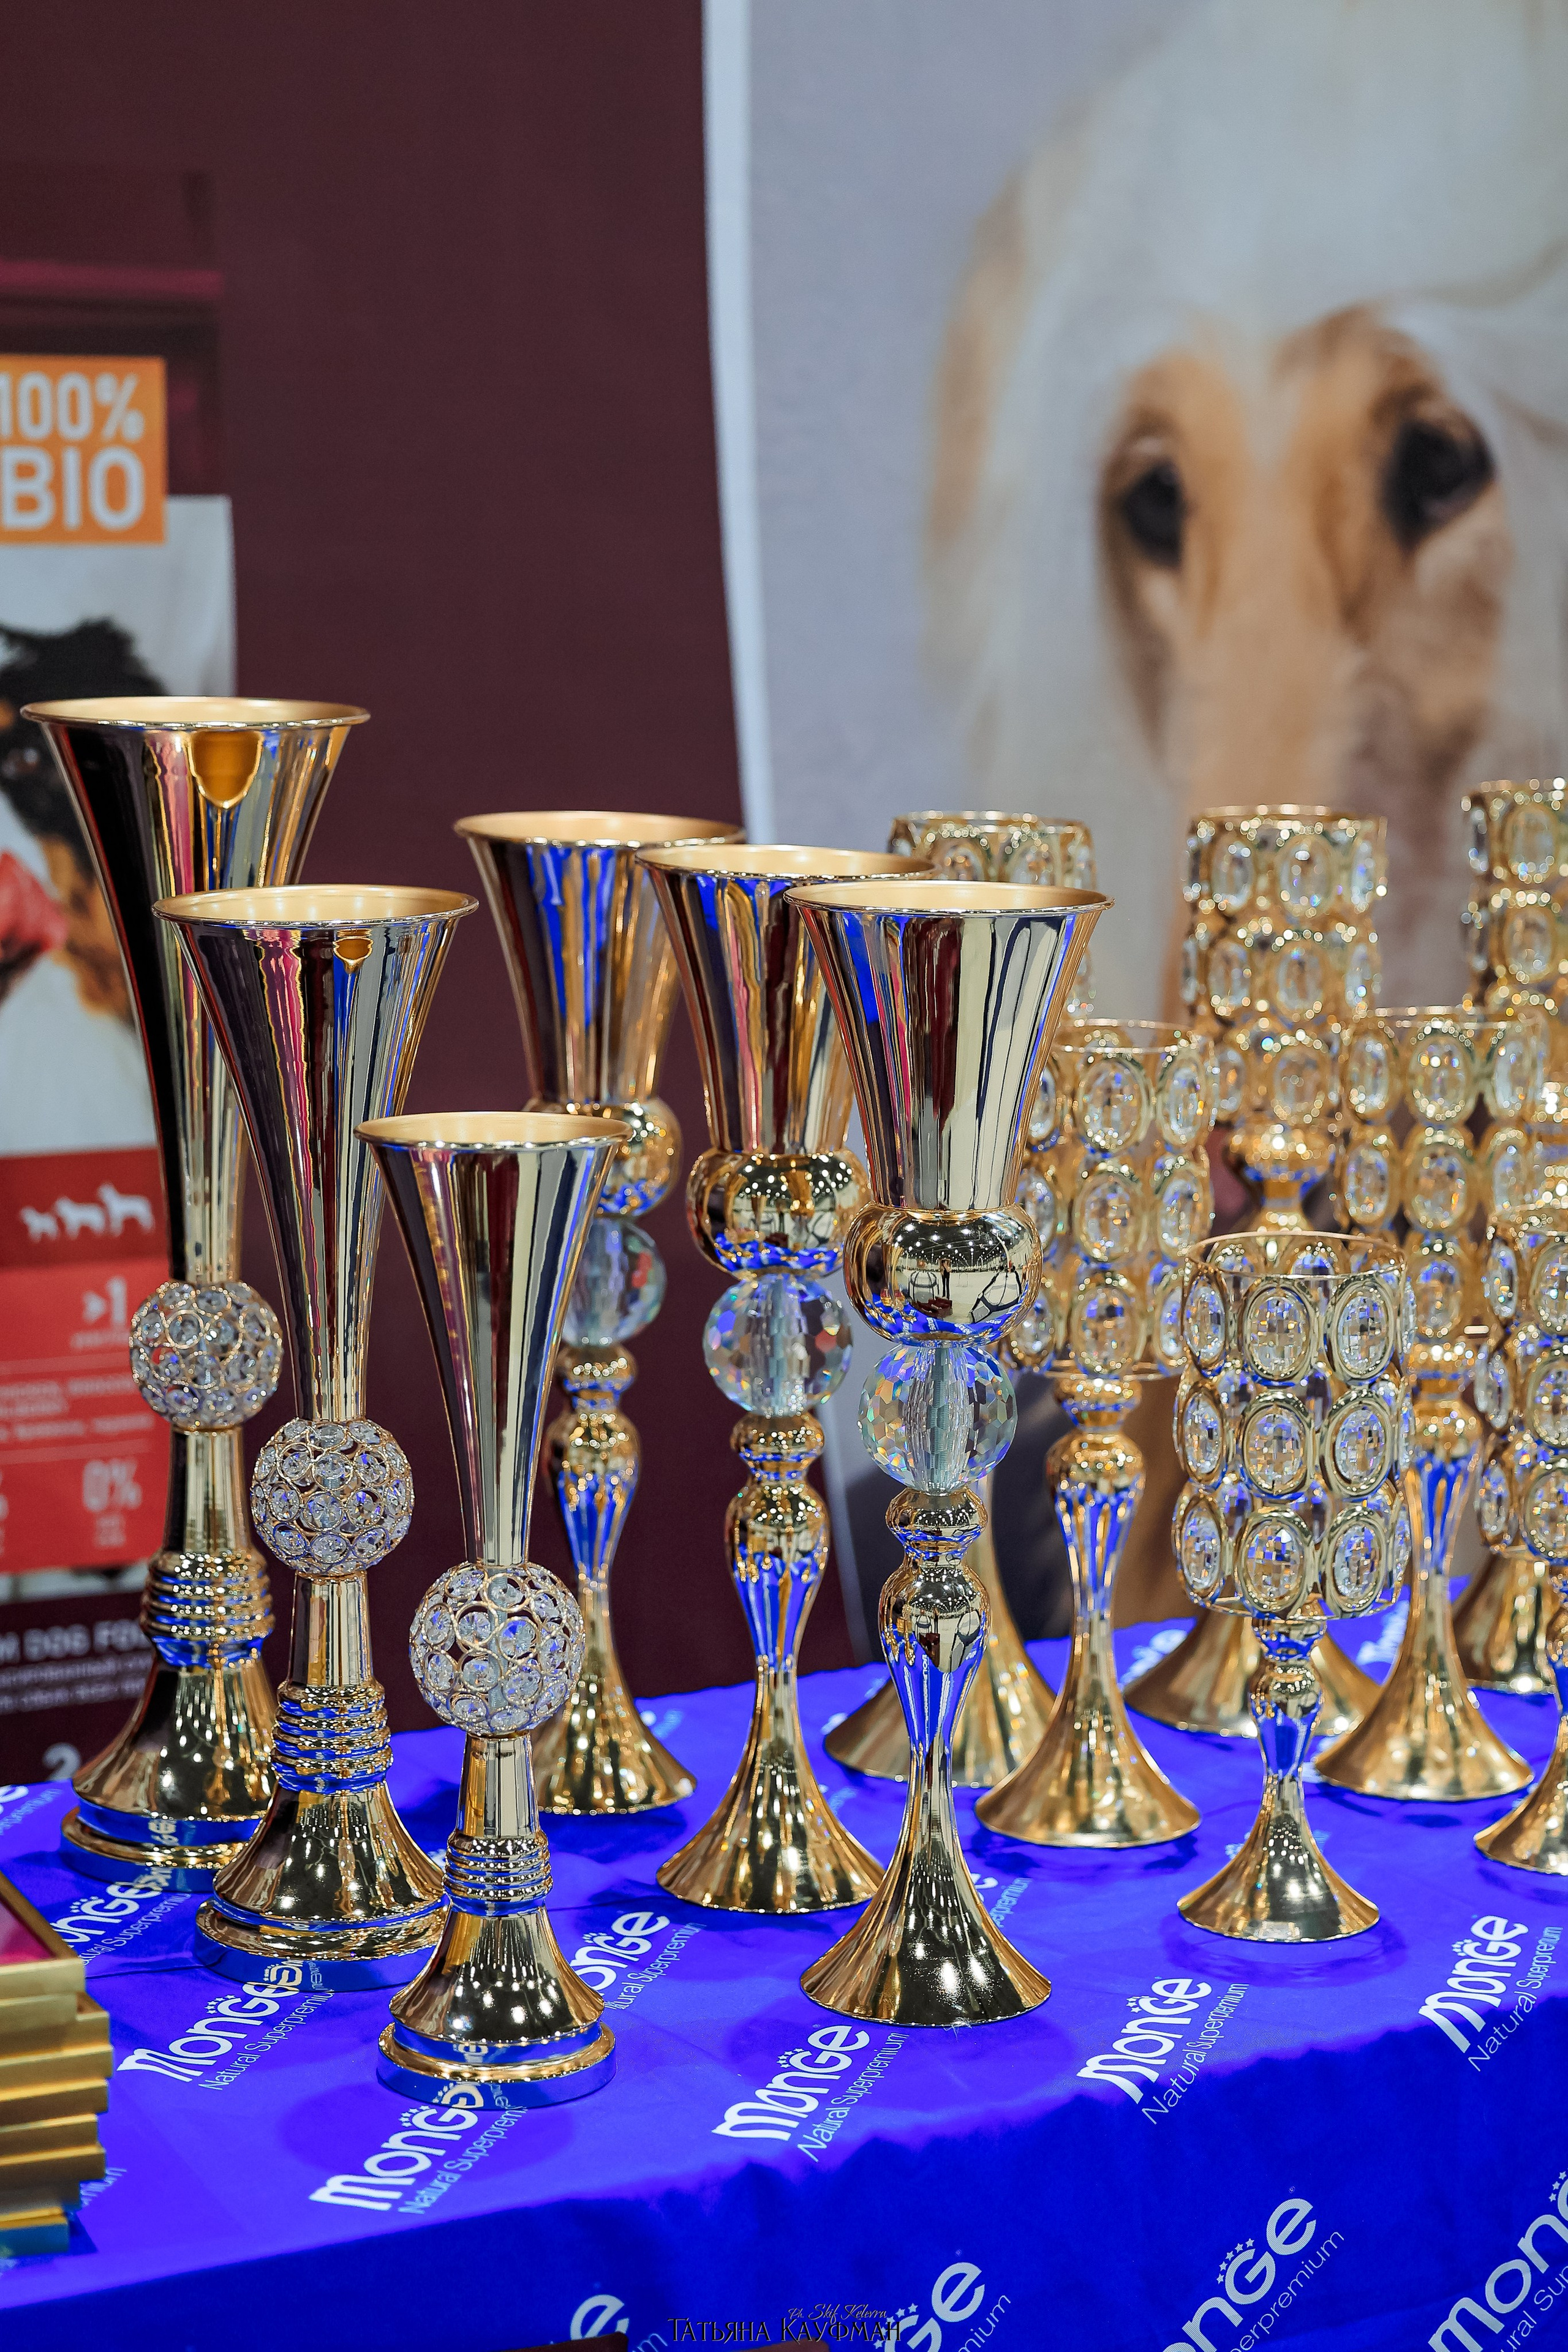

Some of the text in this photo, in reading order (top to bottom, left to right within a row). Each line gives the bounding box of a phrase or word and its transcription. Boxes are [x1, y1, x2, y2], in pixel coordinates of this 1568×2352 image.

[0, 371, 145, 443] 100%
[1, 445, 146, 532] BIO
[569, 1911, 671, 1997] onGe
[198, 1988, 335, 2090] Natural Superpremiu
[1468, 1991, 1537, 2071] Natural
[797, 2031, 910, 2163] Natural Superpremium
[1142, 2049, 1207, 2125] Natural
